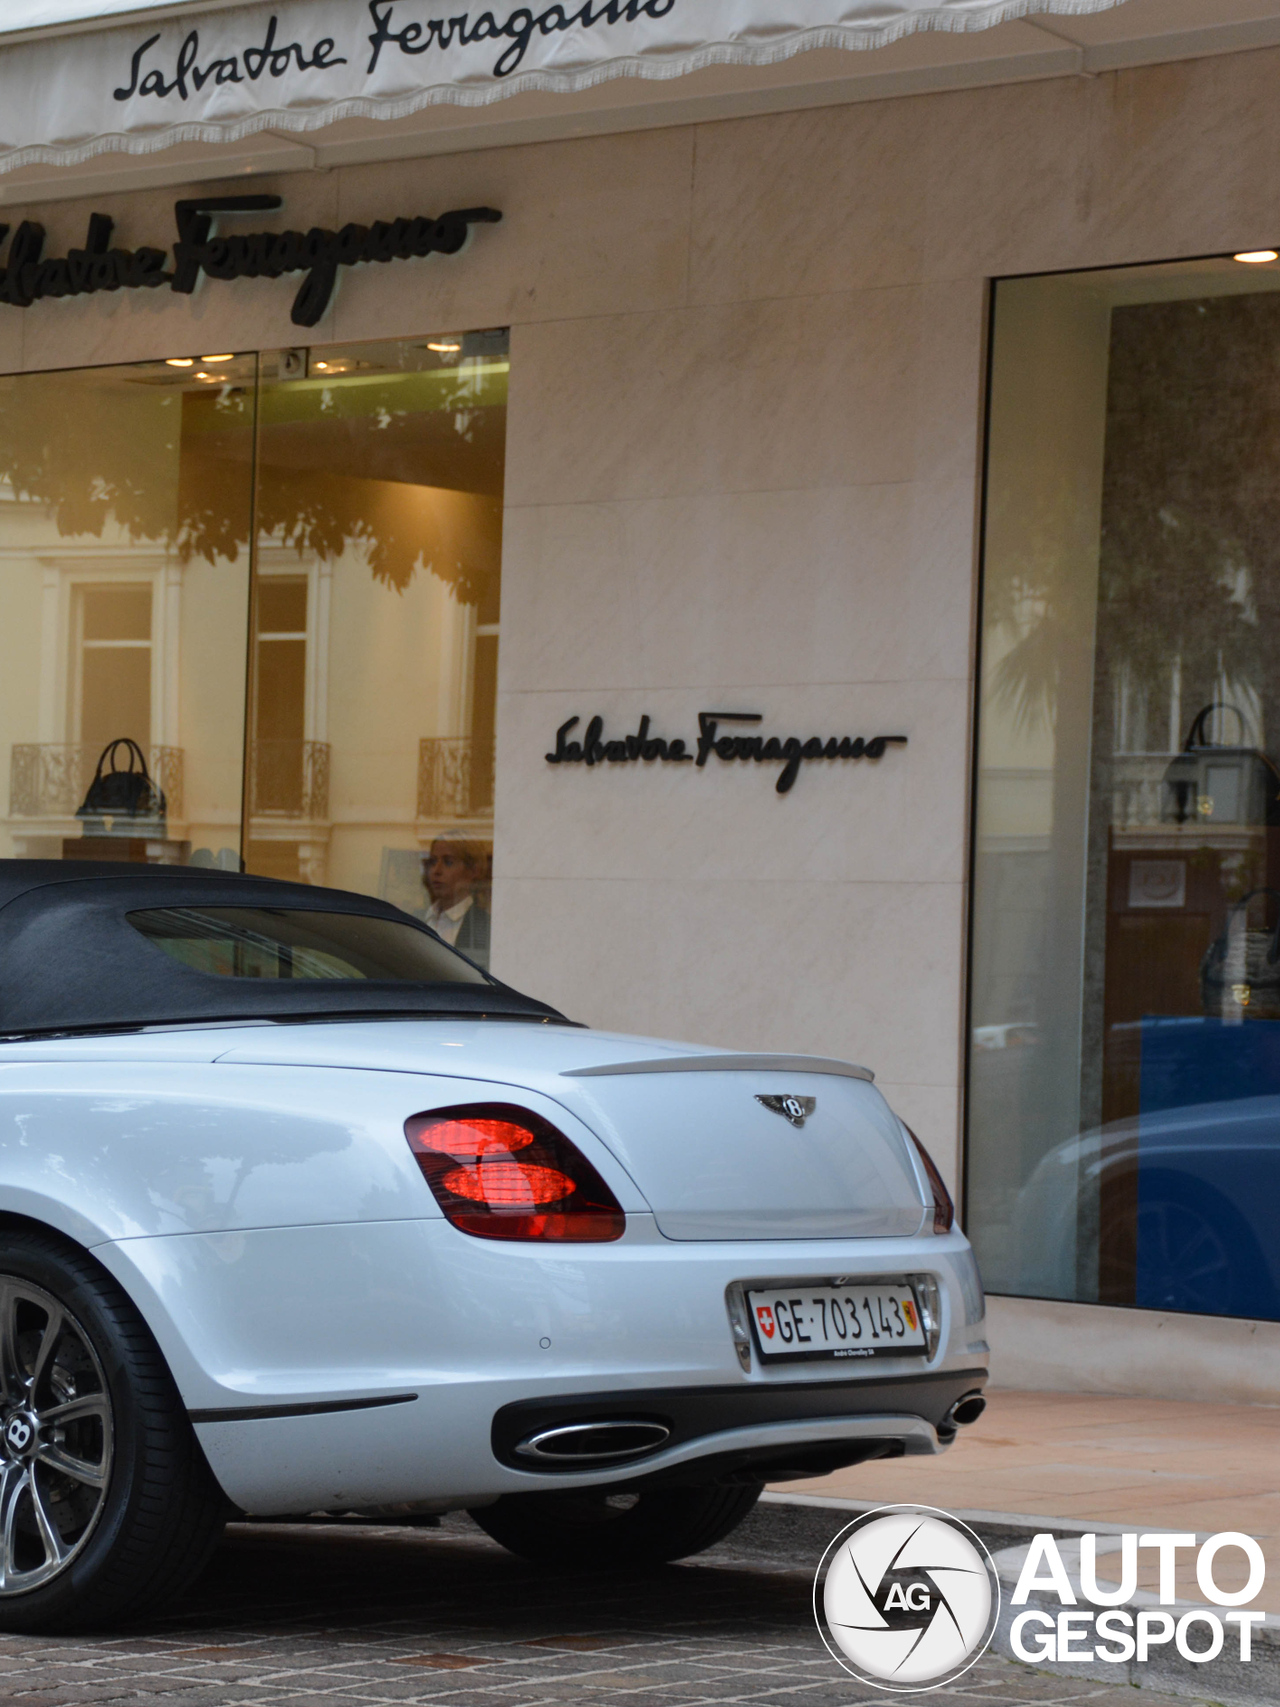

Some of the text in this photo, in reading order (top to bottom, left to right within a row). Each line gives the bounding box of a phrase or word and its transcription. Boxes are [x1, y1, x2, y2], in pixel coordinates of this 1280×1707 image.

[113, 16, 347, 101] Salvatore
[170, 195, 502, 327] Ferragamo
[546, 713, 908, 794] Salvatore Ferragamo
